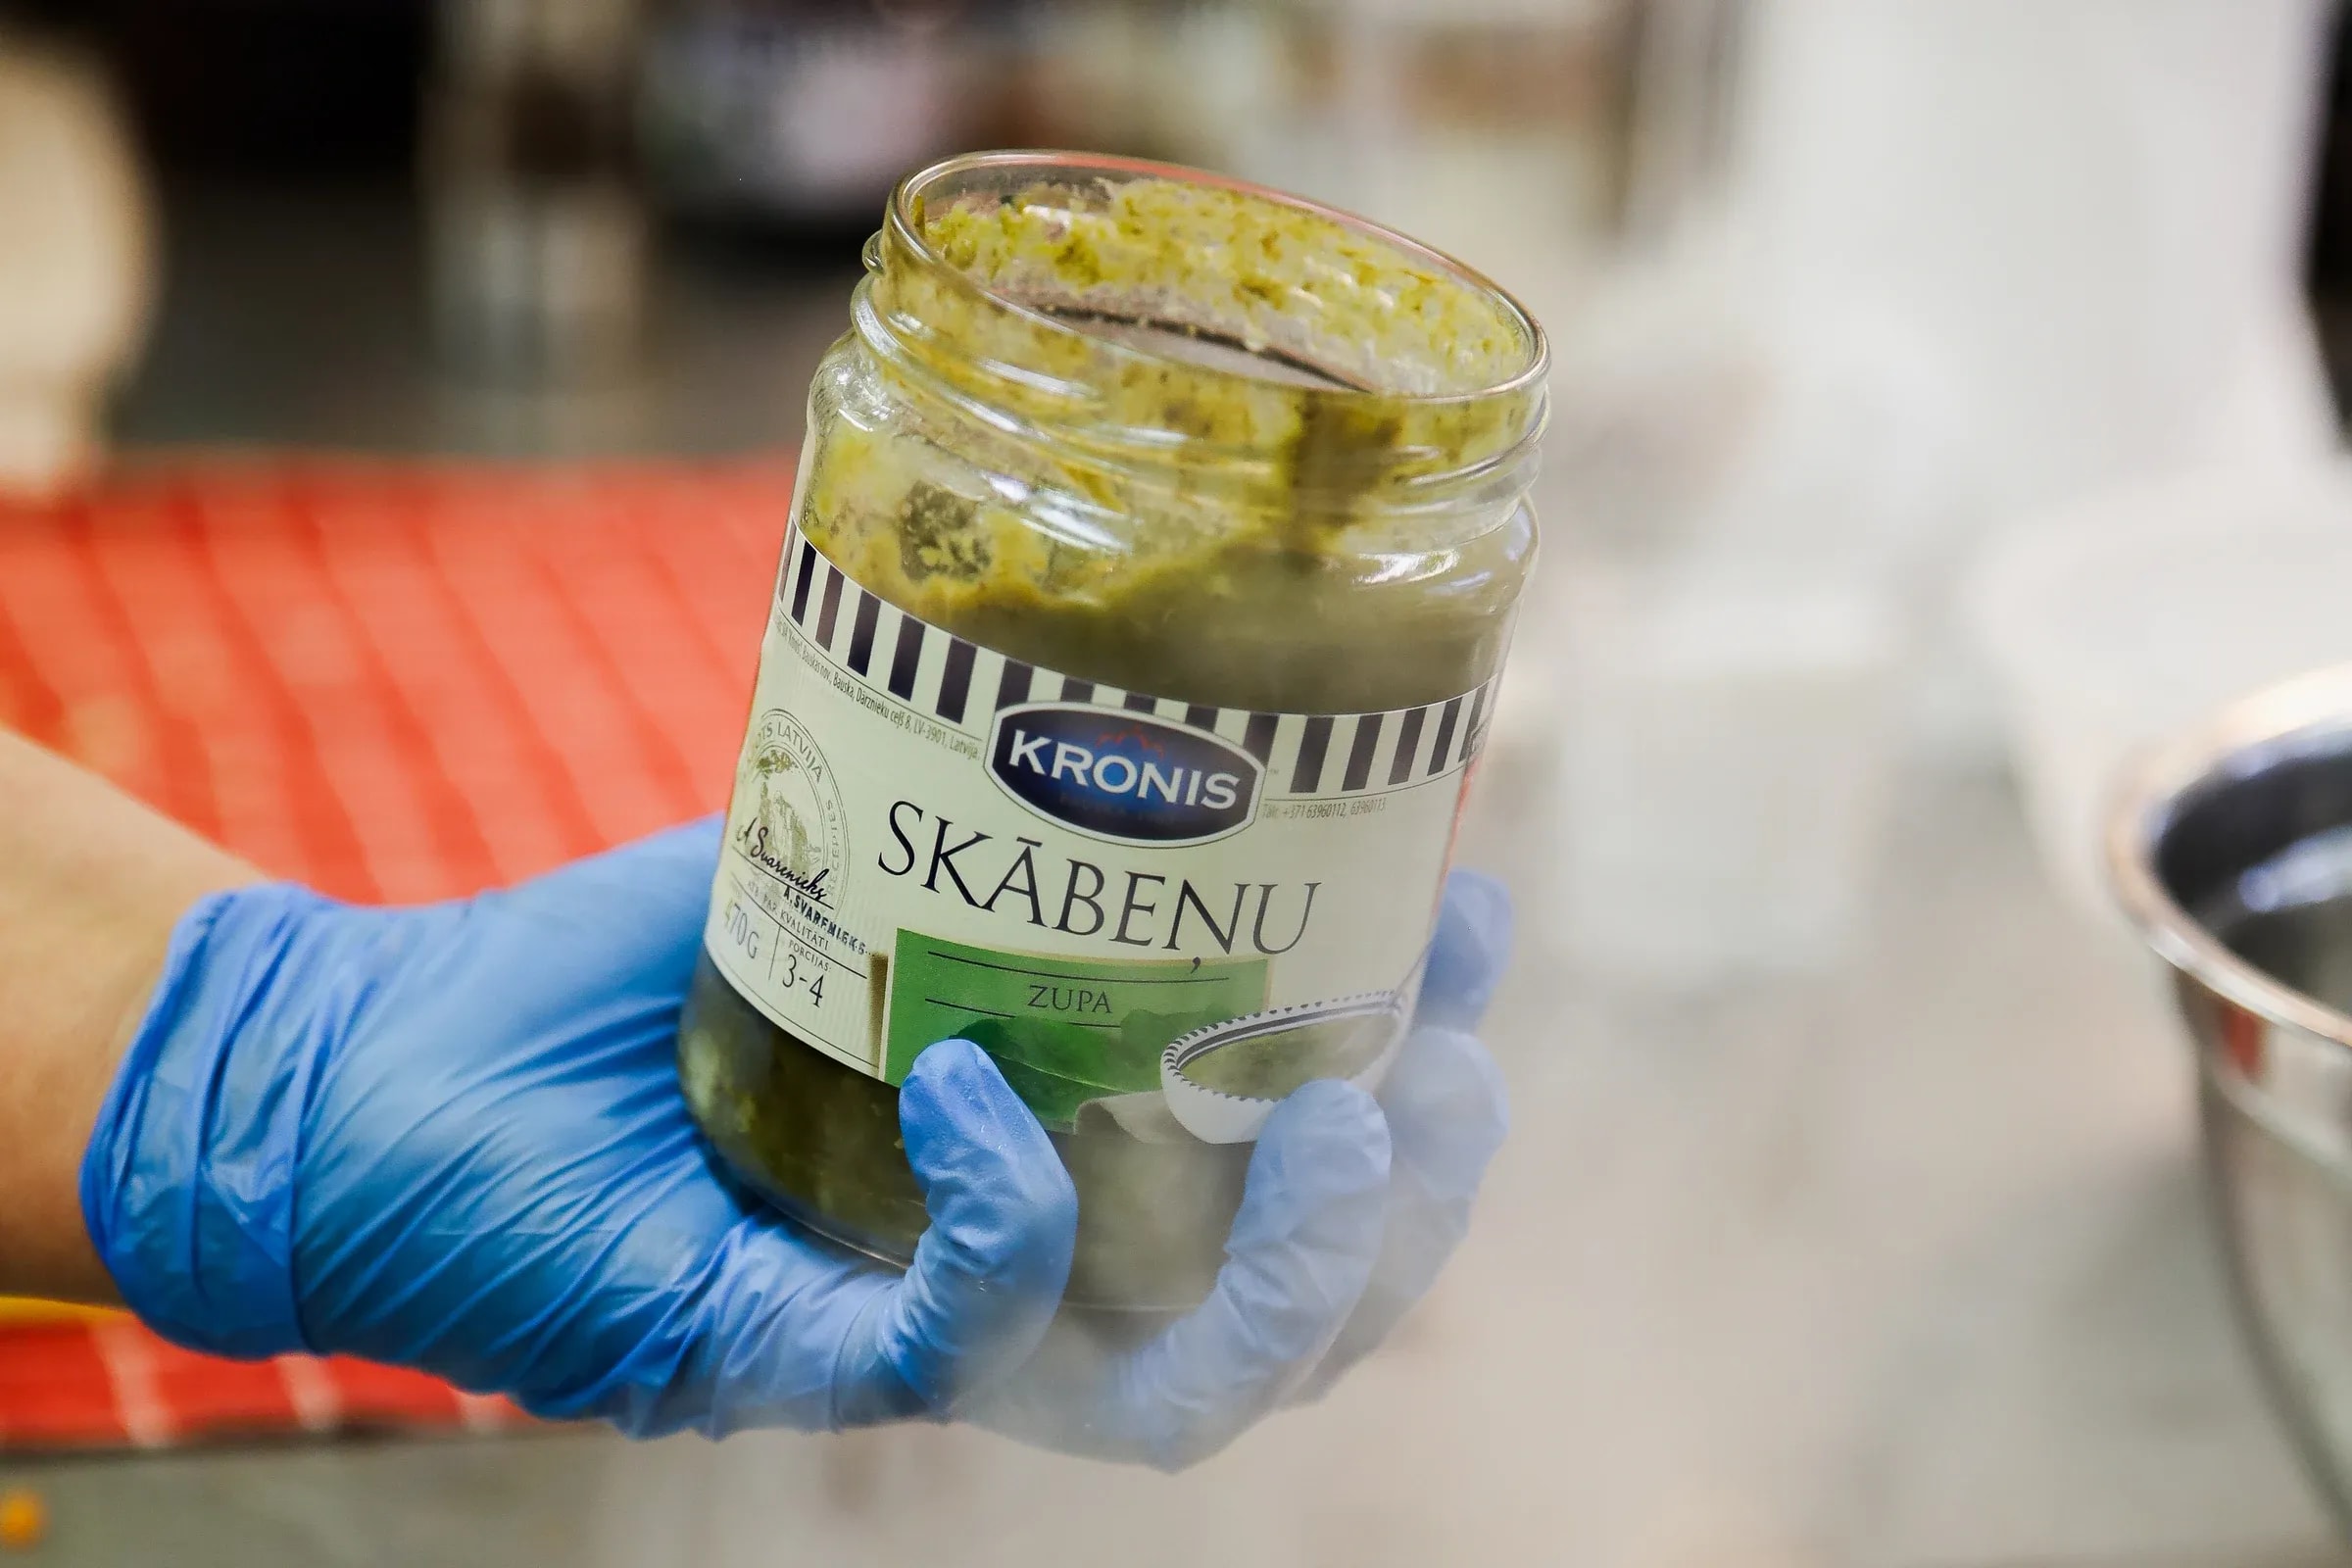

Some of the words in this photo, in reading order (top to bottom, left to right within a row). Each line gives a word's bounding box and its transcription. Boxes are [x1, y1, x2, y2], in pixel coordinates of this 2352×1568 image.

[833, 671, 855, 702] Bauska,
[857, 686, 889, 719] Dārznieku
[890, 709, 905, 730] ceļš
[913, 718, 948, 750] LV-3901,
[1008, 729, 1241, 810] KRONIS
[877, 800, 1322, 974] SKĀBEŅU
[782, 954, 824, 1008] 3-4
[1027, 985, 1113, 1015] ZUPA
